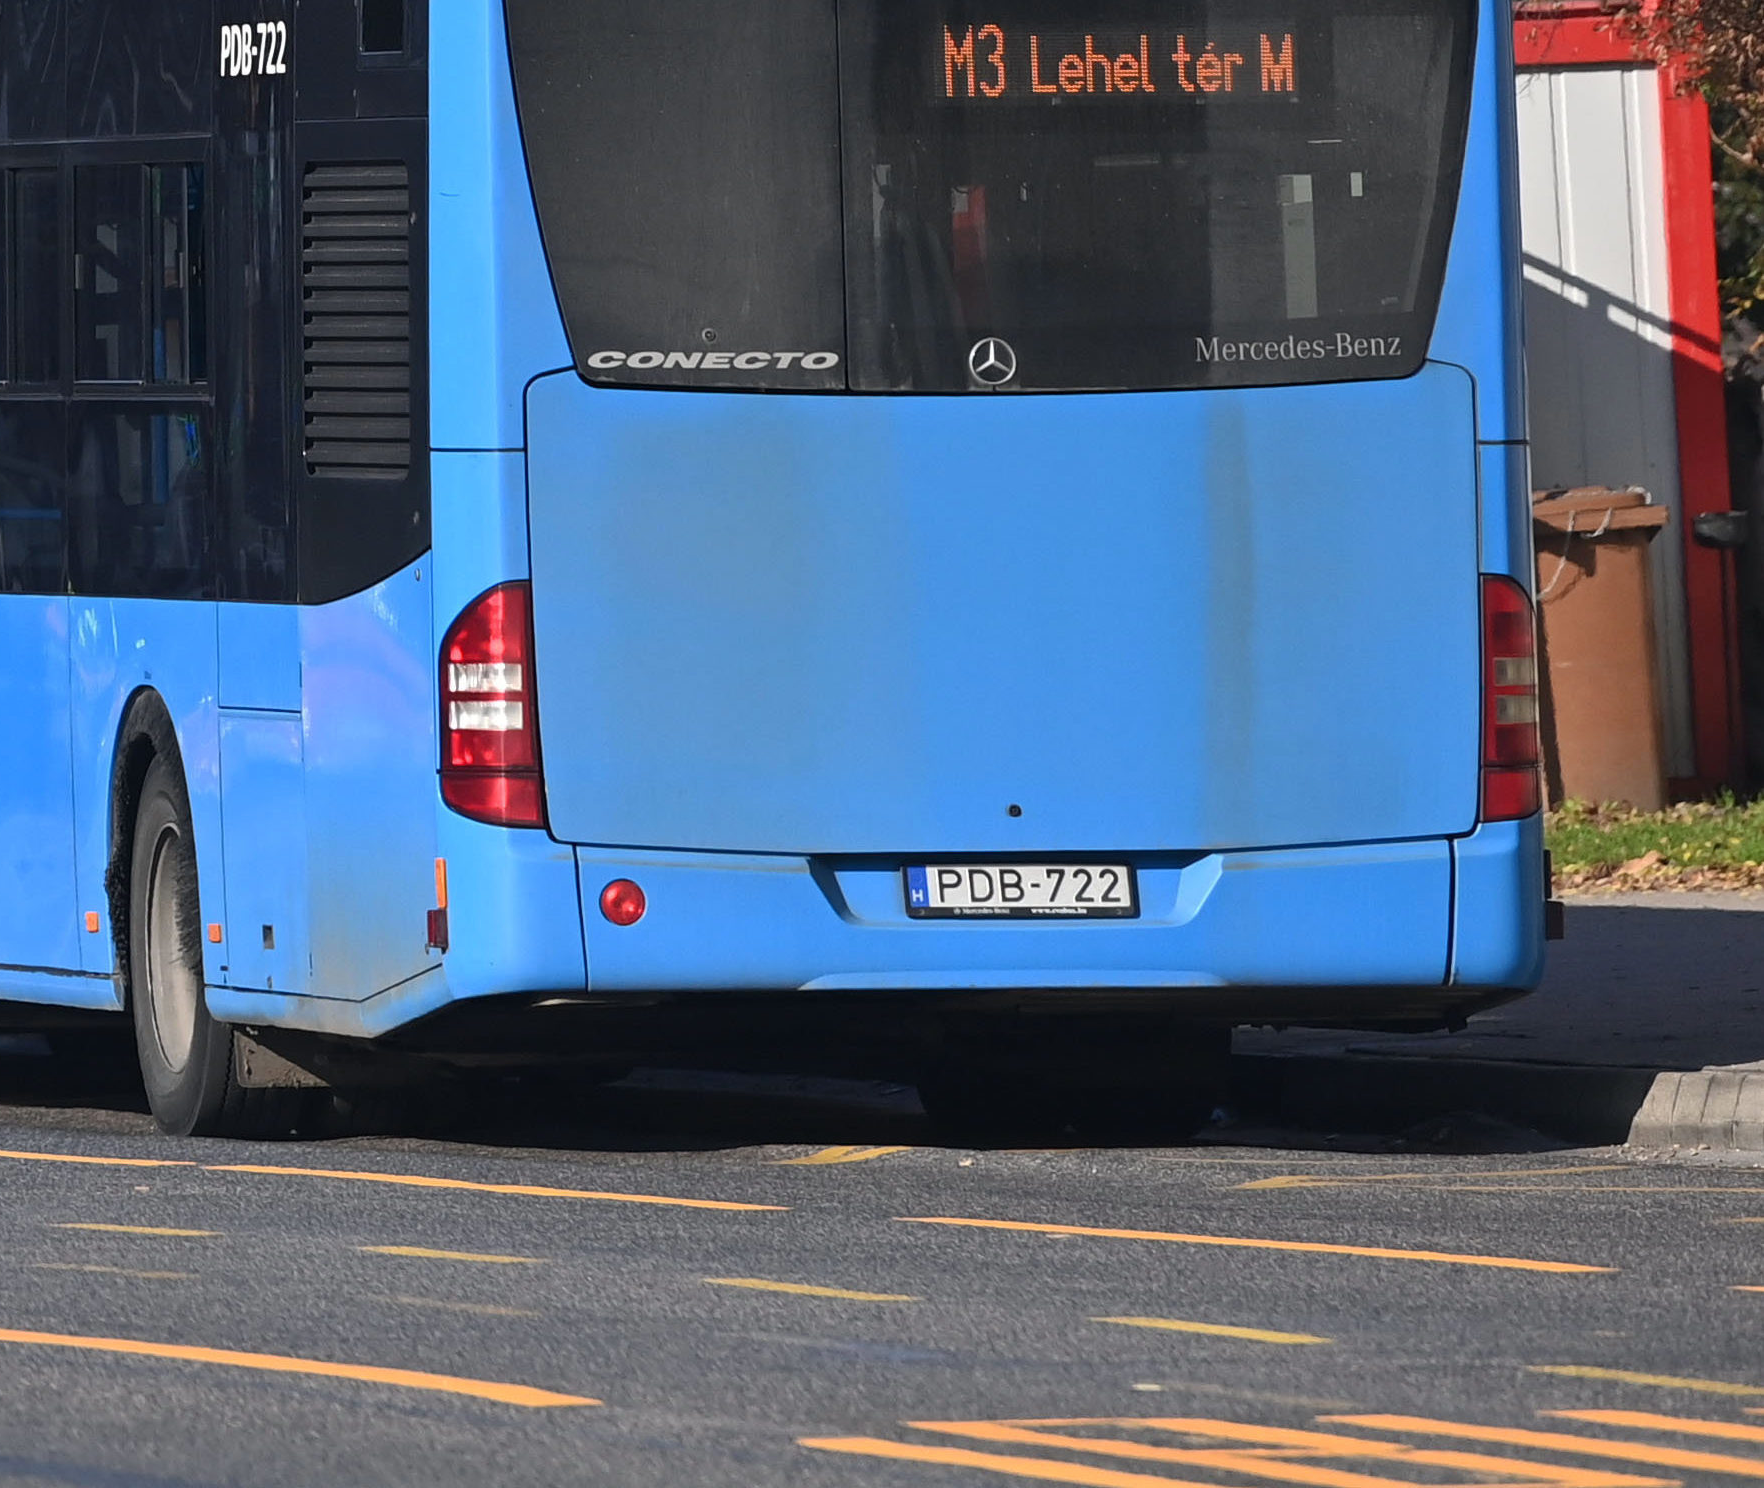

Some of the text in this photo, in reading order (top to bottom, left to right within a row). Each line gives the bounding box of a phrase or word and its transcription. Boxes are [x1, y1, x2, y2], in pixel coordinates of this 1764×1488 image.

[220, 20, 287, 78] PDB-722
[943, 23, 1296, 97] M3 Lehel tér M
[587, 351, 839, 370] CONECTO
[1194, 332, 1402, 362] Mercedes-Benz
[912, 868, 1122, 903] H PDB-722
